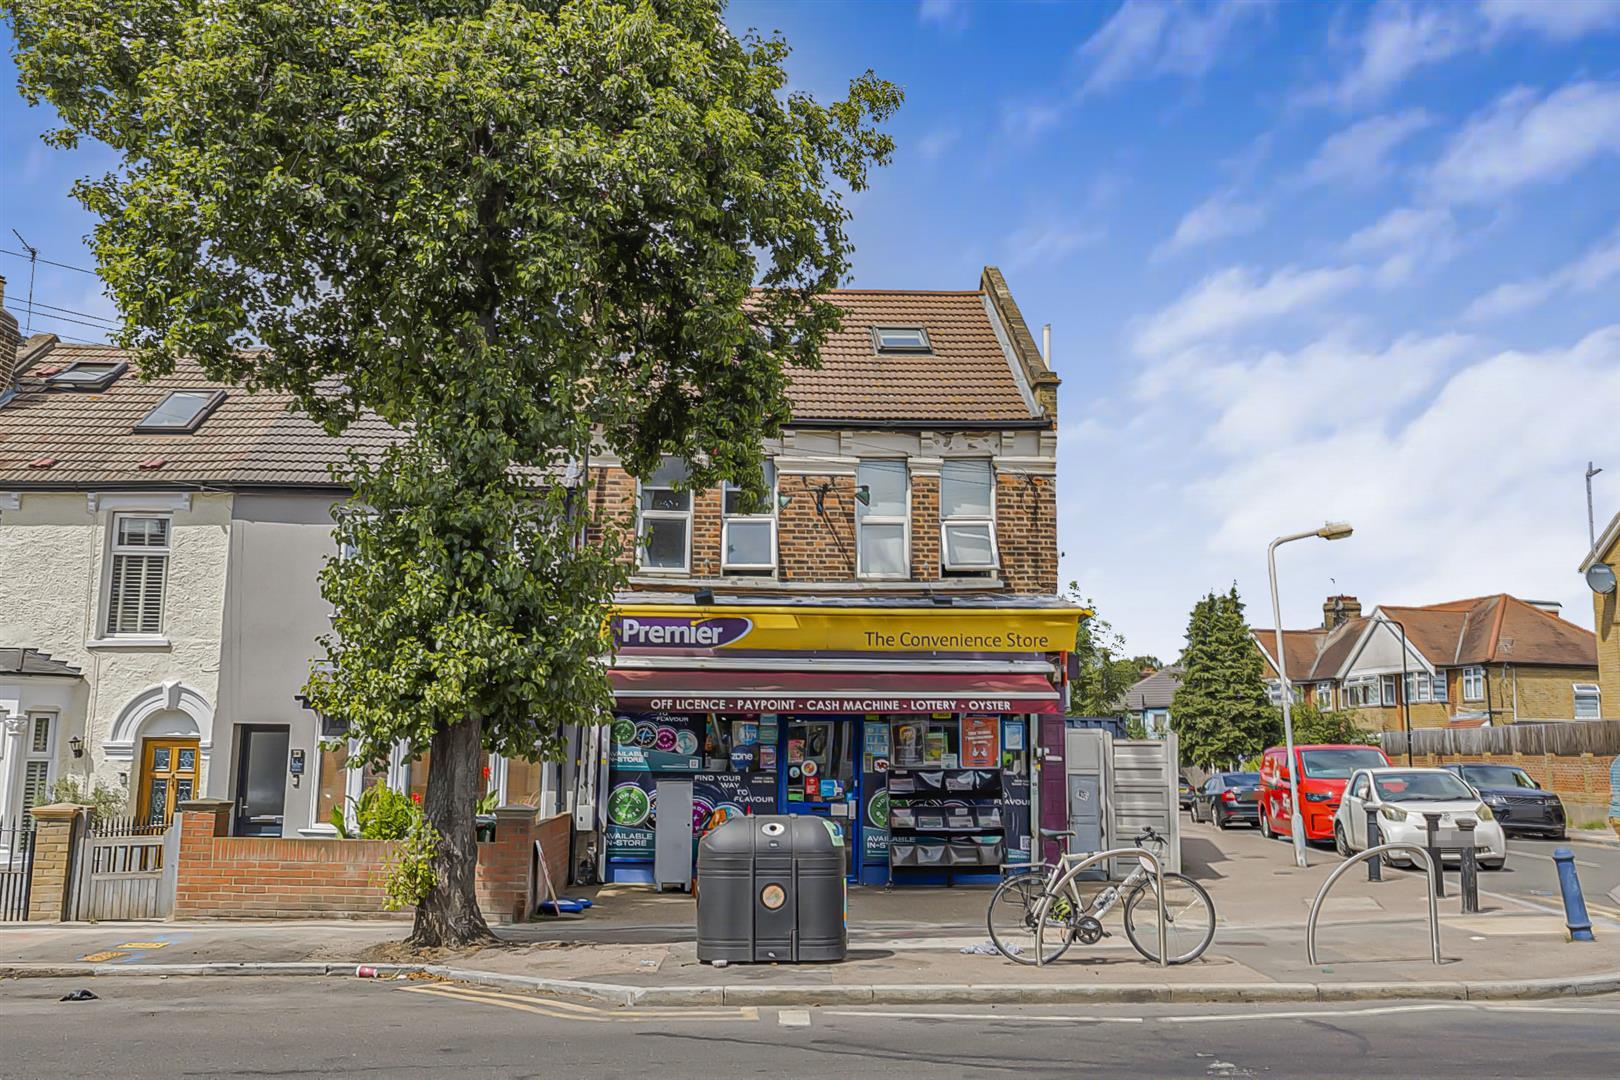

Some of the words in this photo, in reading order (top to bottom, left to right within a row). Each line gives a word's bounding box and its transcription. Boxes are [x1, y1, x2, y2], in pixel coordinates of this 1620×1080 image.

[622, 618, 723, 644] Premier
[864, 632, 895, 647] The
[900, 632, 1001, 648] Convenience
[1006, 633, 1049, 648] Store
[651, 699, 673, 710] OFF
[676, 699, 726, 710] LICENCE
[737, 699, 796, 711] PAYPOINT
[807, 700, 841, 711] CASH
[843, 700, 899, 711] MACHINE
[911, 700, 957, 711] LOTTERY
[968, 700, 1011, 711] OYSTER
[607, 839, 647, 847] N-STORE
